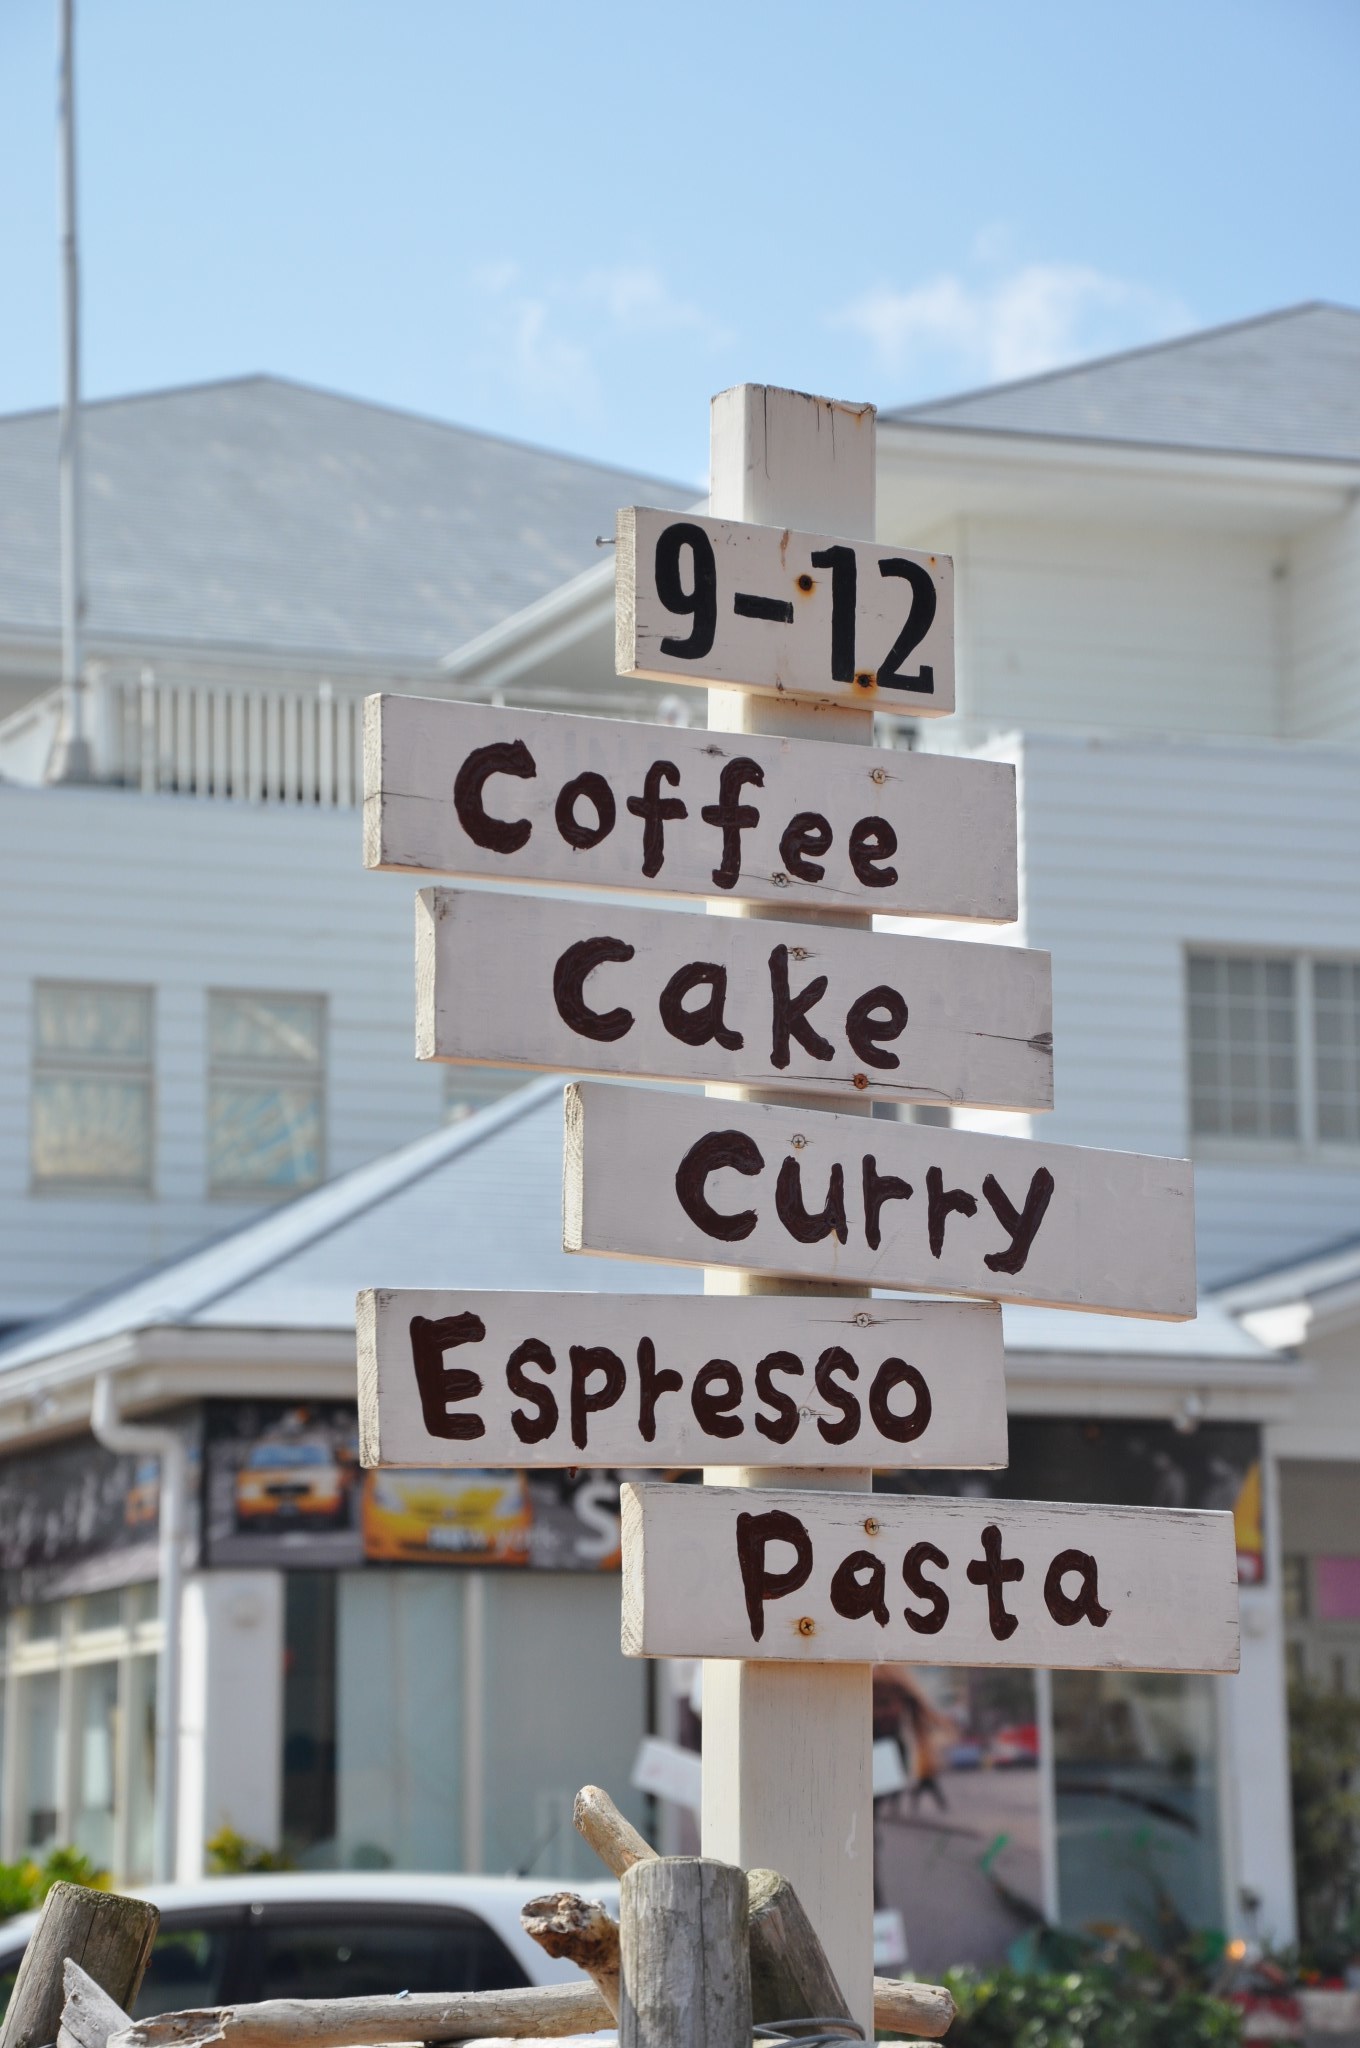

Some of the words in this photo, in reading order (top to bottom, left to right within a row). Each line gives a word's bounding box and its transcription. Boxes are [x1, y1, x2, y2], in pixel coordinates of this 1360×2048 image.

[654, 522, 937, 695] 9-12
[453, 739, 899, 890] Coffee
[552, 935, 909, 1070] Cake
[675, 1129, 1055, 1276] Curry
[409, 1310, 933, 1451] Espresso
[735, 1509, 1112, 1643] Pasta
